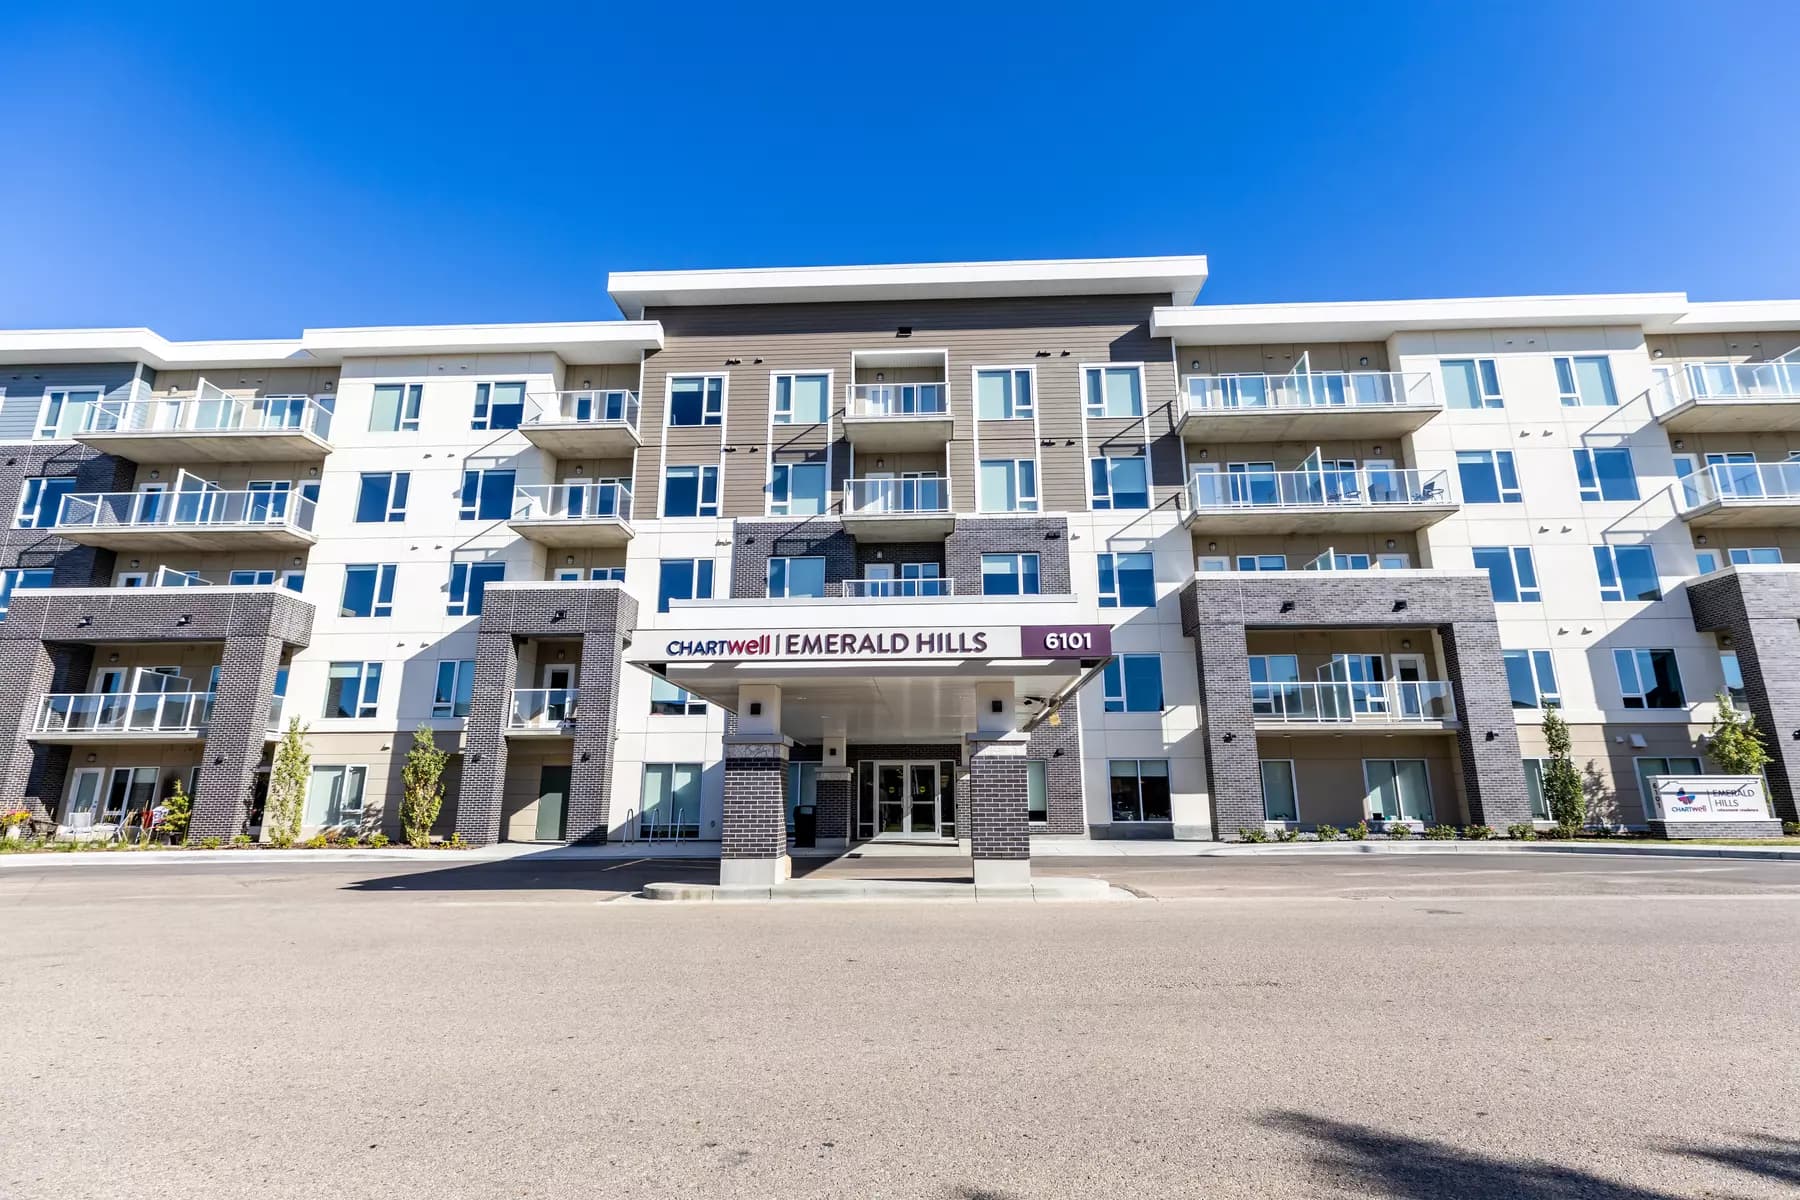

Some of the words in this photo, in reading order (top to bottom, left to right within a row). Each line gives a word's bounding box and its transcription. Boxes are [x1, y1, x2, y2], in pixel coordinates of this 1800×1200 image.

[666, 633, 771, 656] CHARTwell
[785, 632, 910, 655] EMERALD
[916, 631, 988, 654] HILLS
[1044, 632, 1092, 650] 6101
[1712, 789, 1755, 798] EMERALD
[1714, 799, 1740, 807] HILLS
